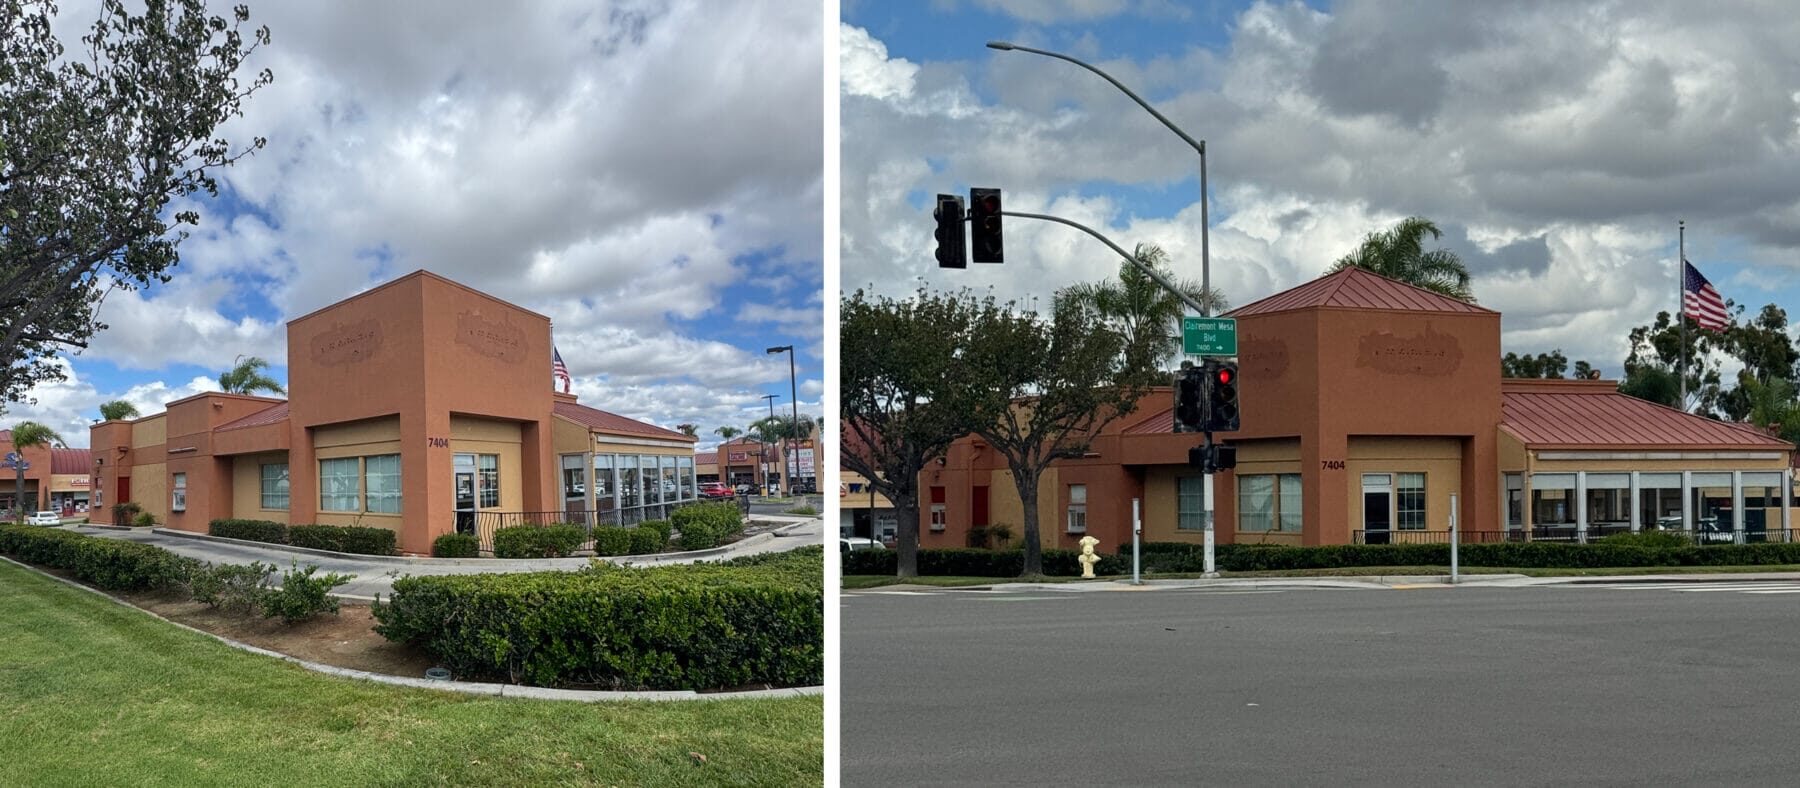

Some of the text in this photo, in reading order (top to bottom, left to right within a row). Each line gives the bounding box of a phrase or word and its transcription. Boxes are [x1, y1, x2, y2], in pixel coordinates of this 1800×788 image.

[1184, 320, 1234, 331] Clairemont Mesa
[1203, 332, 1216, 342] Blvd
[428, 437, 449, 448] 7404
[1321, 460, 1346, 470] 7404
